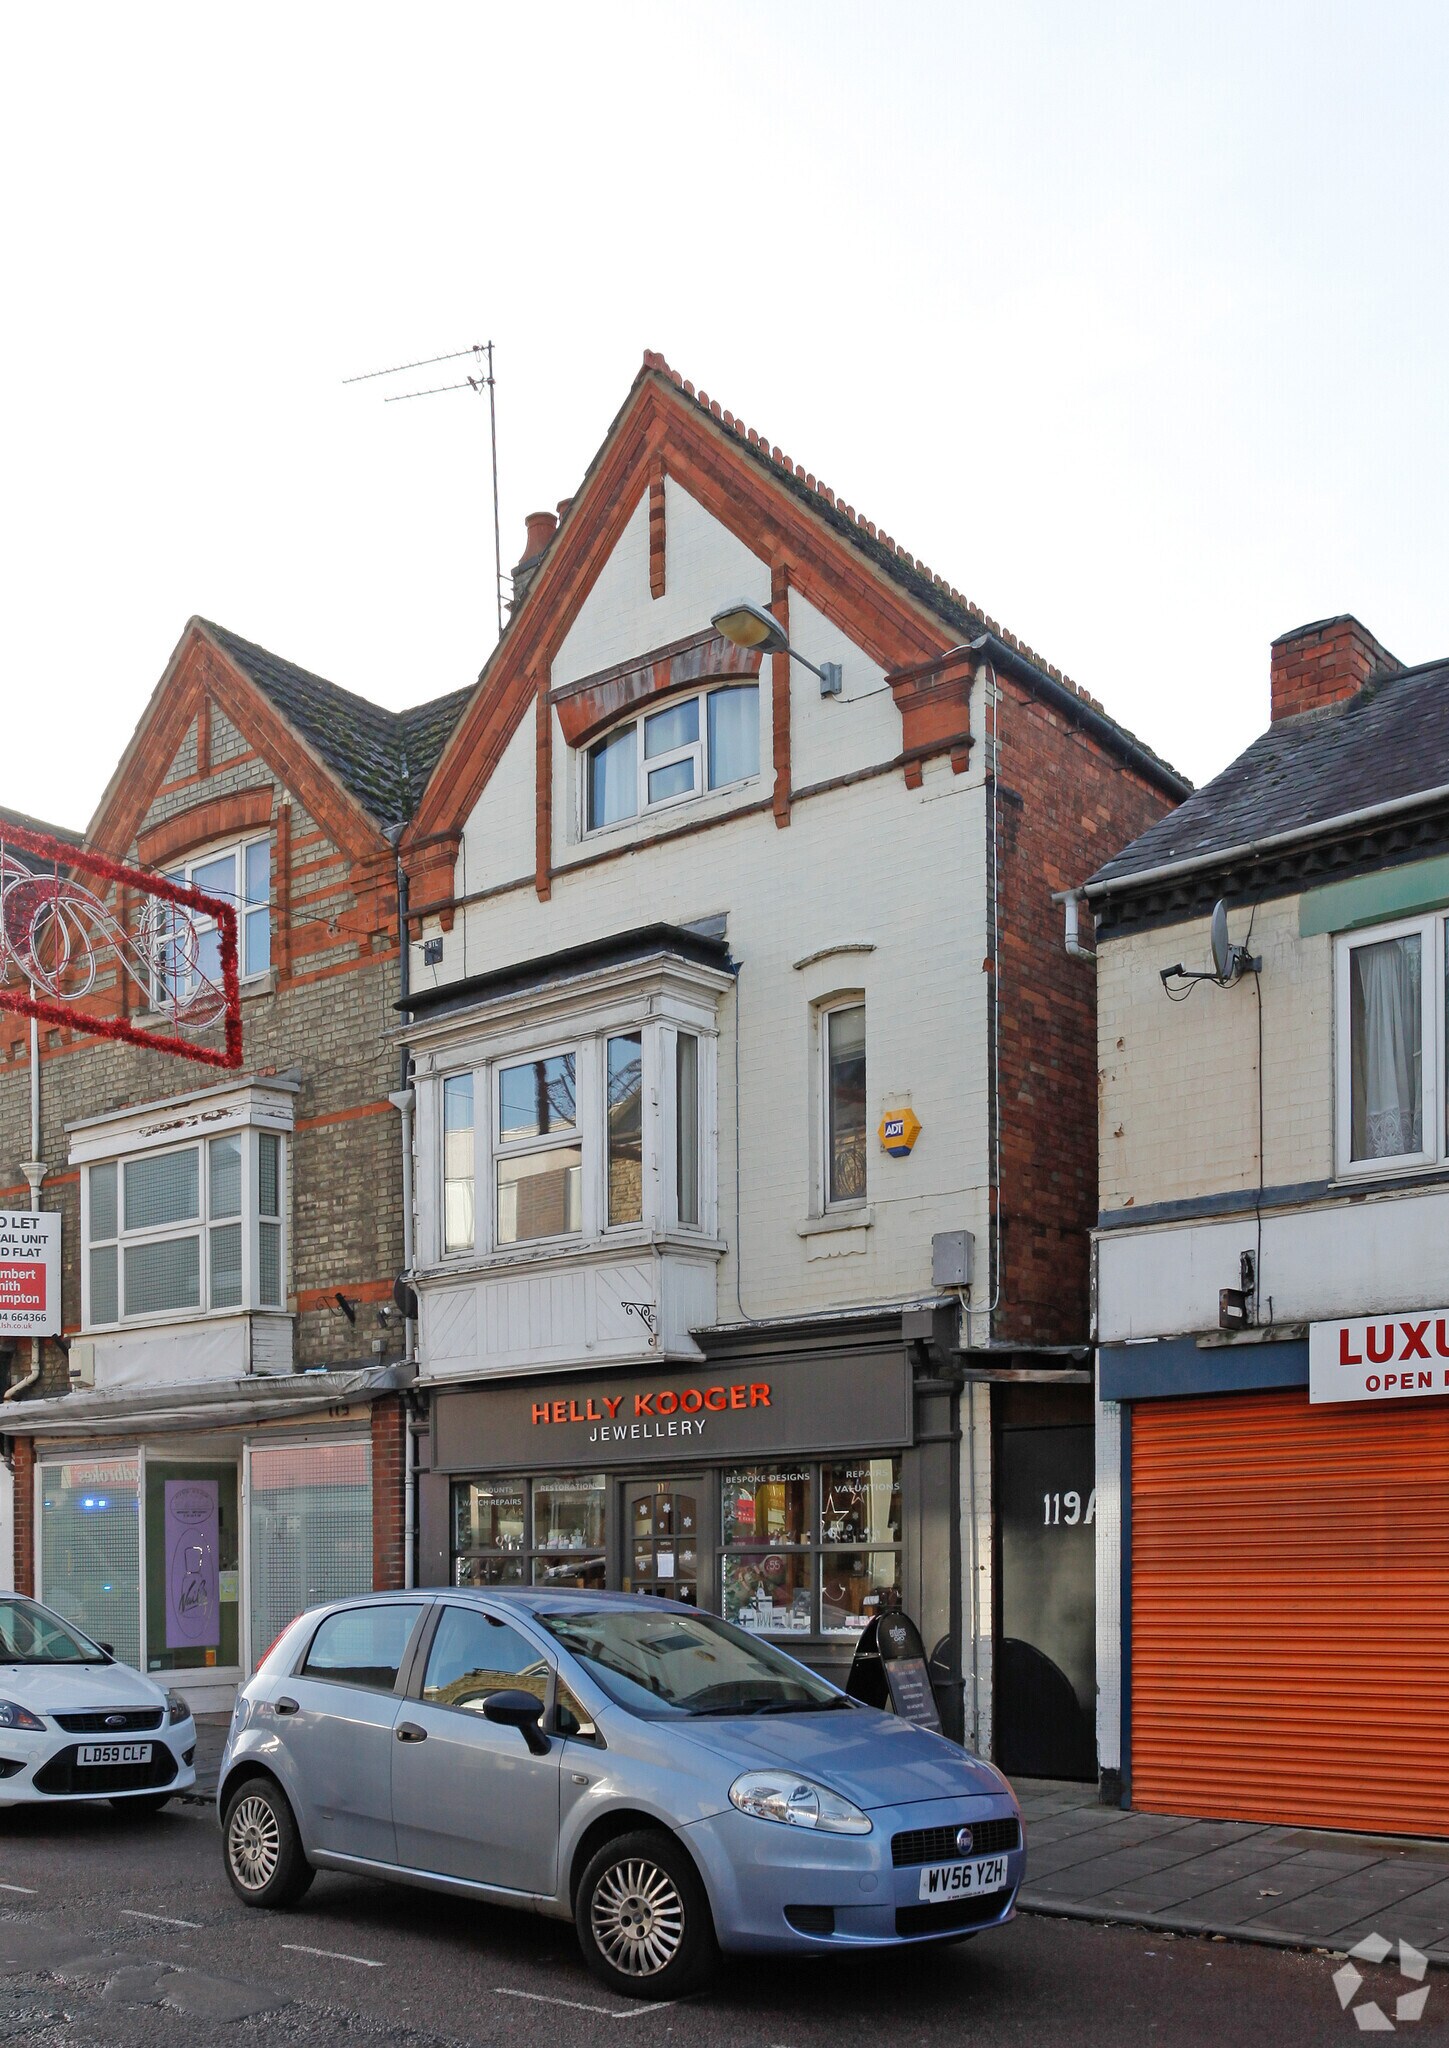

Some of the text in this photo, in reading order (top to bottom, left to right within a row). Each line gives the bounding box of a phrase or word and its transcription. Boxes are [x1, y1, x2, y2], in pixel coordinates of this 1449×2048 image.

[885, 1121, 904, 1136] ADT
[12, 1217, 40, 1230] LET
[0, 1233, 49, 1244] AIL UNIT
[12, 1247, 42, 1258] FLAT
[0, 1293, 40, 1306] mpton
[0, 1312, 47, 1322] 4 664366
[1365, 1371, 1433, 1393] OPEN
[531, 1382, 772, 1425] HELLY KOOGER
[589, 1419, 707, 1442] JEWELLERY
[725, 1472, 811, 1484] BESPOKE DESIGNS
[845, 1469, 889, 1479] REPAIRS
[540, 1482, 601, 1492] RESTORATIONS
[490, 1498, 522, 1506] REPAIRS
[83, 1746, 148, 1763] LD59 CLF
[928, 1858, 1003, 1893] WV56 YZH
